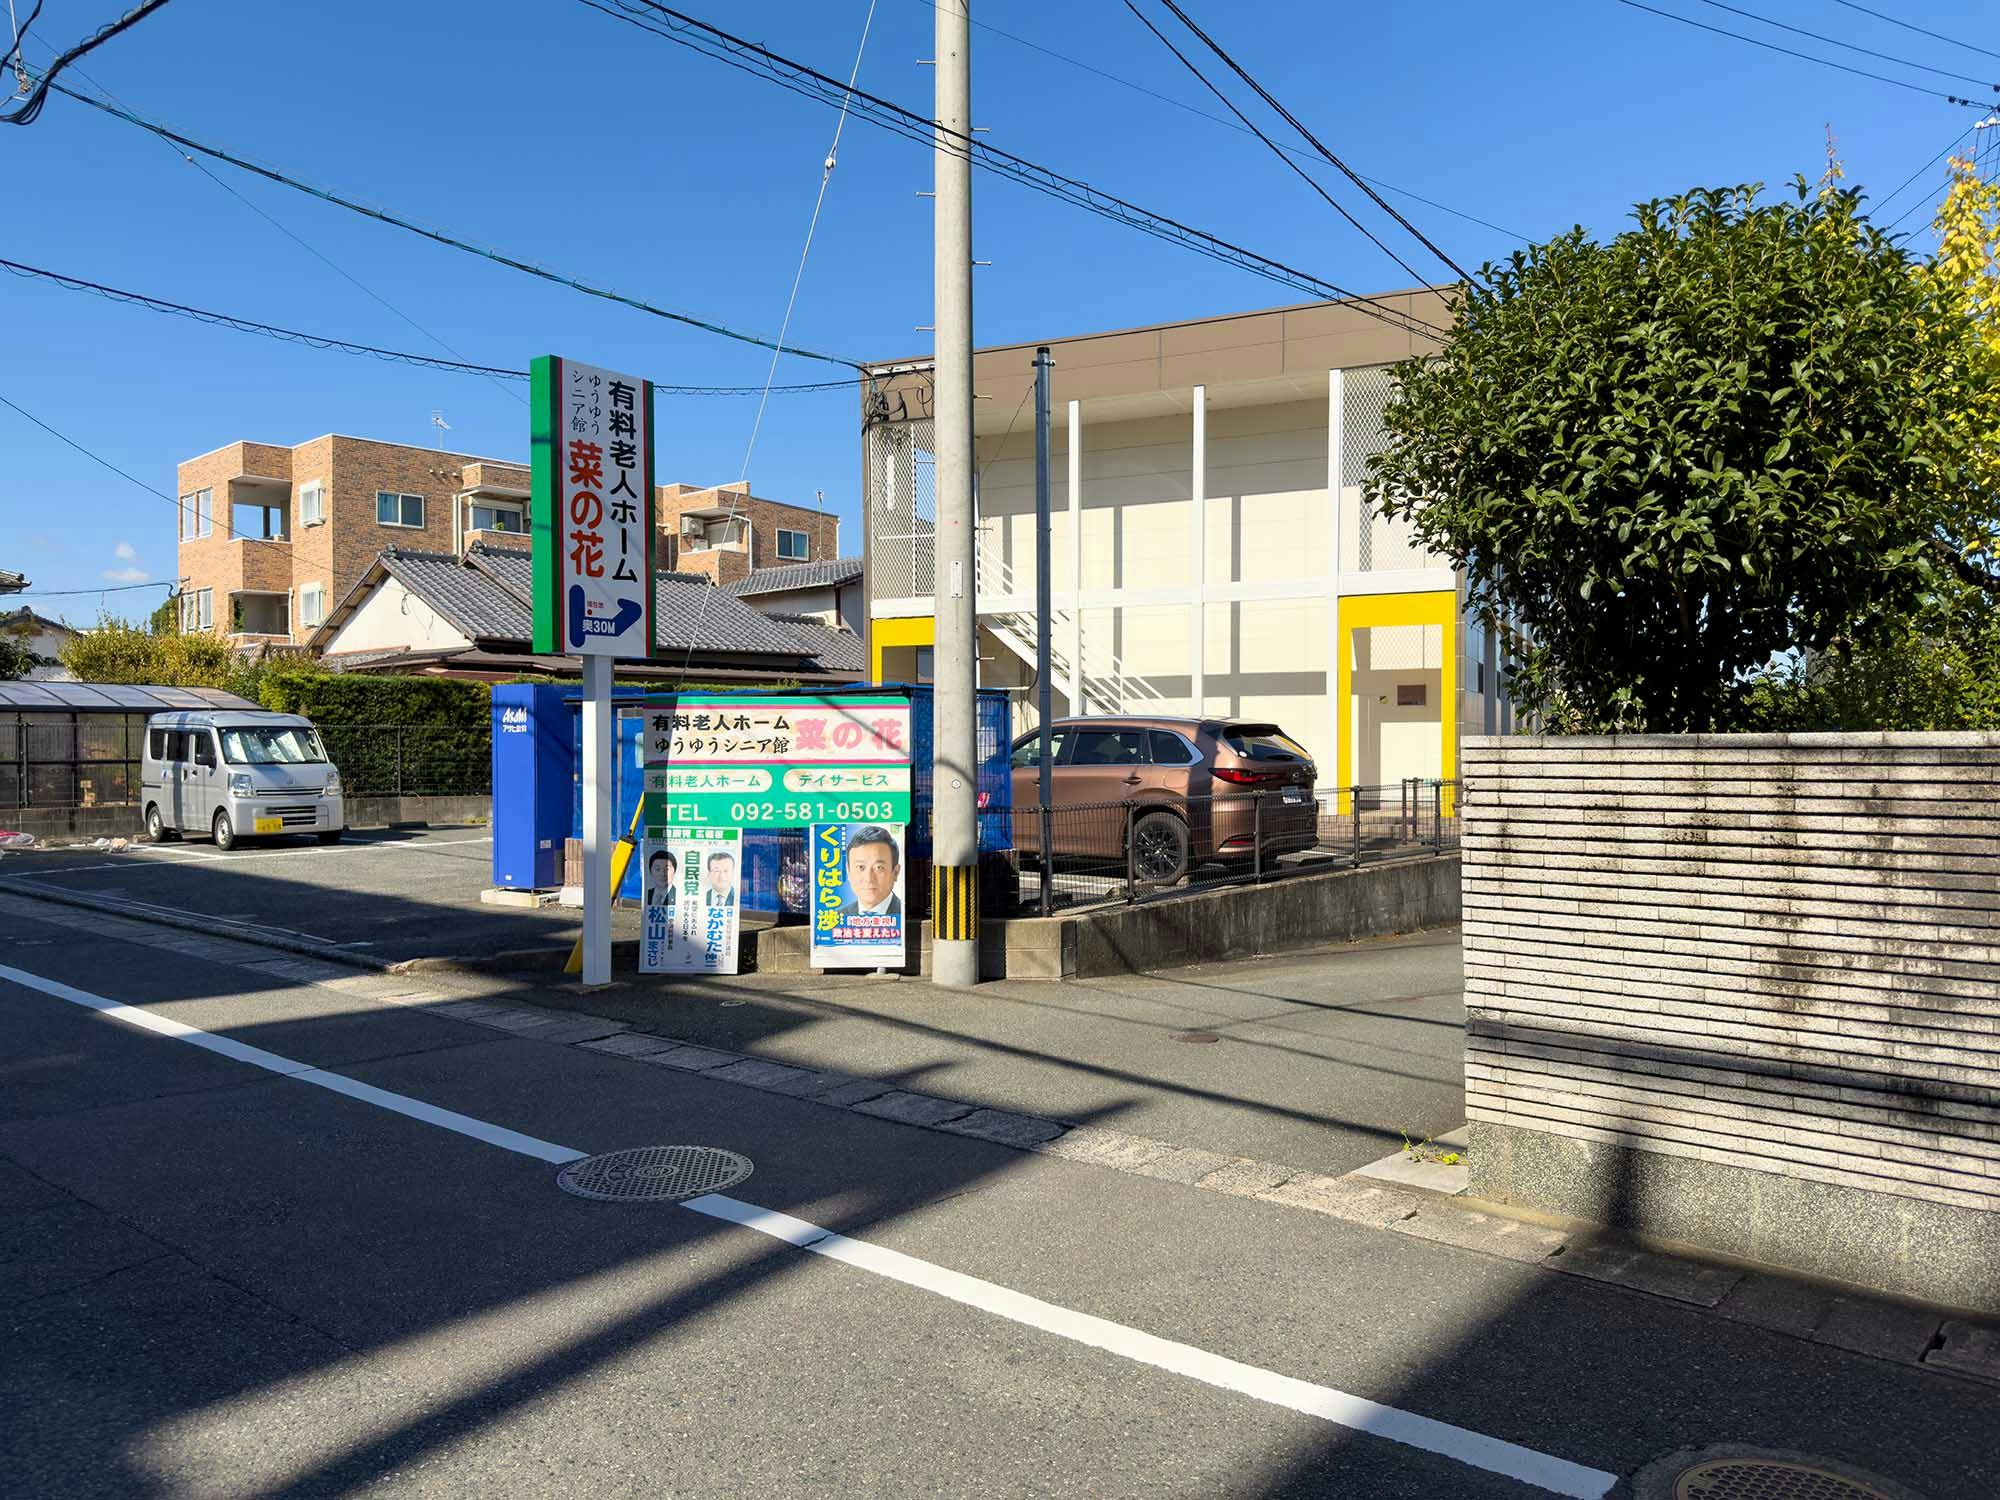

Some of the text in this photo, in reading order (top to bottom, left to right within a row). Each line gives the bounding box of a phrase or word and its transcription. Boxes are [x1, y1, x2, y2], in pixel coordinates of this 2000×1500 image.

[571, 370, 587, 433] シニア館
[588, 374, 601, 435] ゆうゆう
[608, 381, 638, 583] 有料老人ホーム
[568, 438, 604, 578] 菜の花
[582, 619, 616, 635] 奥30M
[502, 707, 527, 723] Asahi
[652, 714, 790, 731] 有料老人ホーム
[795, 718, 903, 750] 菜の花
[654, 736, 790, 755] ゆうゆうシニア館
[651, 774, 761, 788] 有料老人ホーム
[799, 774, 889, 787] デイサービス
[661, 802, 893, 822] TEL 092-581-0503
[684, 850, 701, 896] 自民党
[817, 825, 842, 931] くりはら渉
[647, 906, 667, 968] 松山まさじ
[705, 907, 724, 967] なかむた伸二
